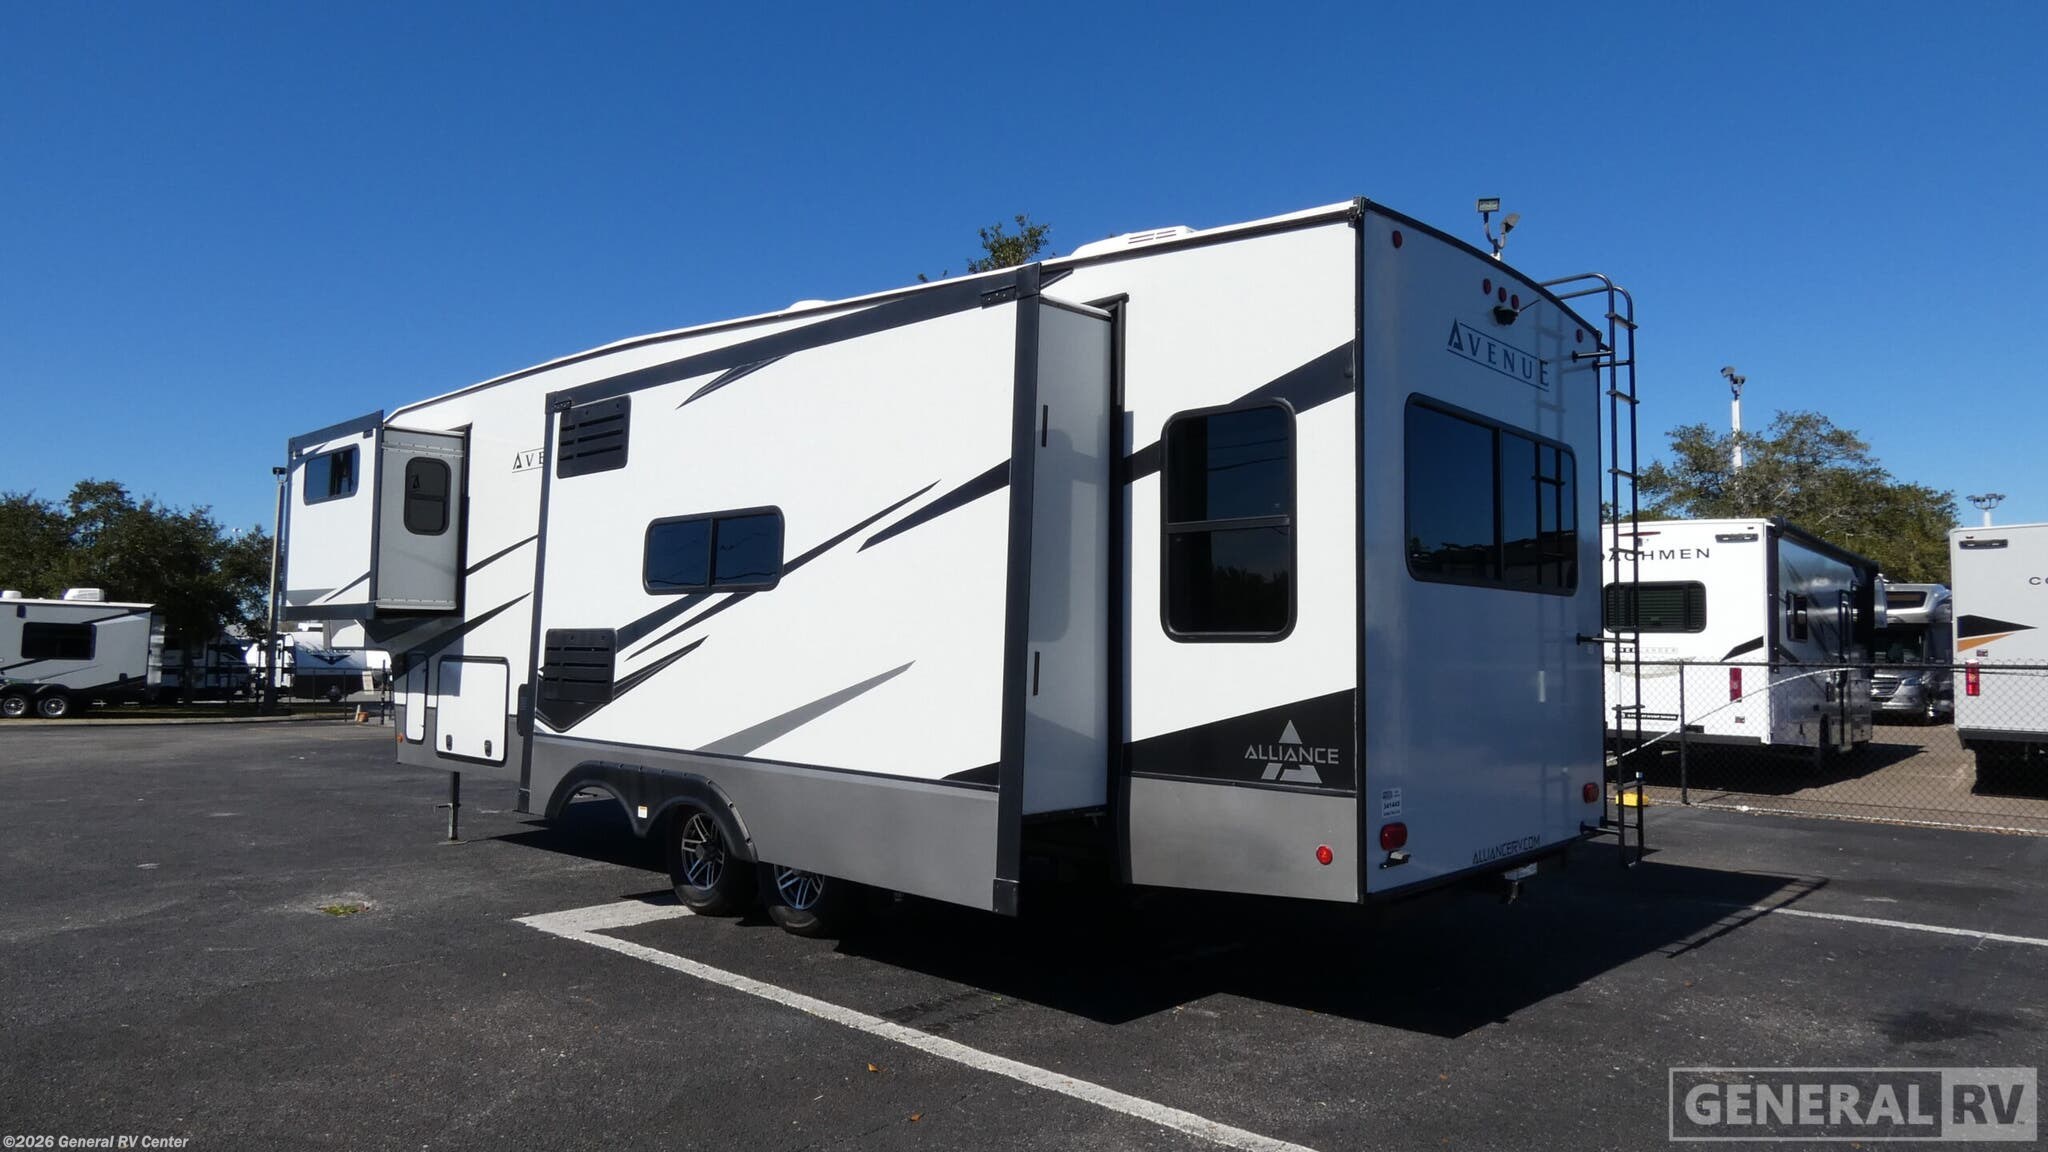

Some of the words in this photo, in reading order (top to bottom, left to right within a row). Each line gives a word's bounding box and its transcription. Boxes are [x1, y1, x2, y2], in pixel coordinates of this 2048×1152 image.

[1447, 318, 1550, 388] AVENUE
[1602, 546, 1710, 562] ACHMEN
[1244, 744, 1339, 765] ALLIANCE
